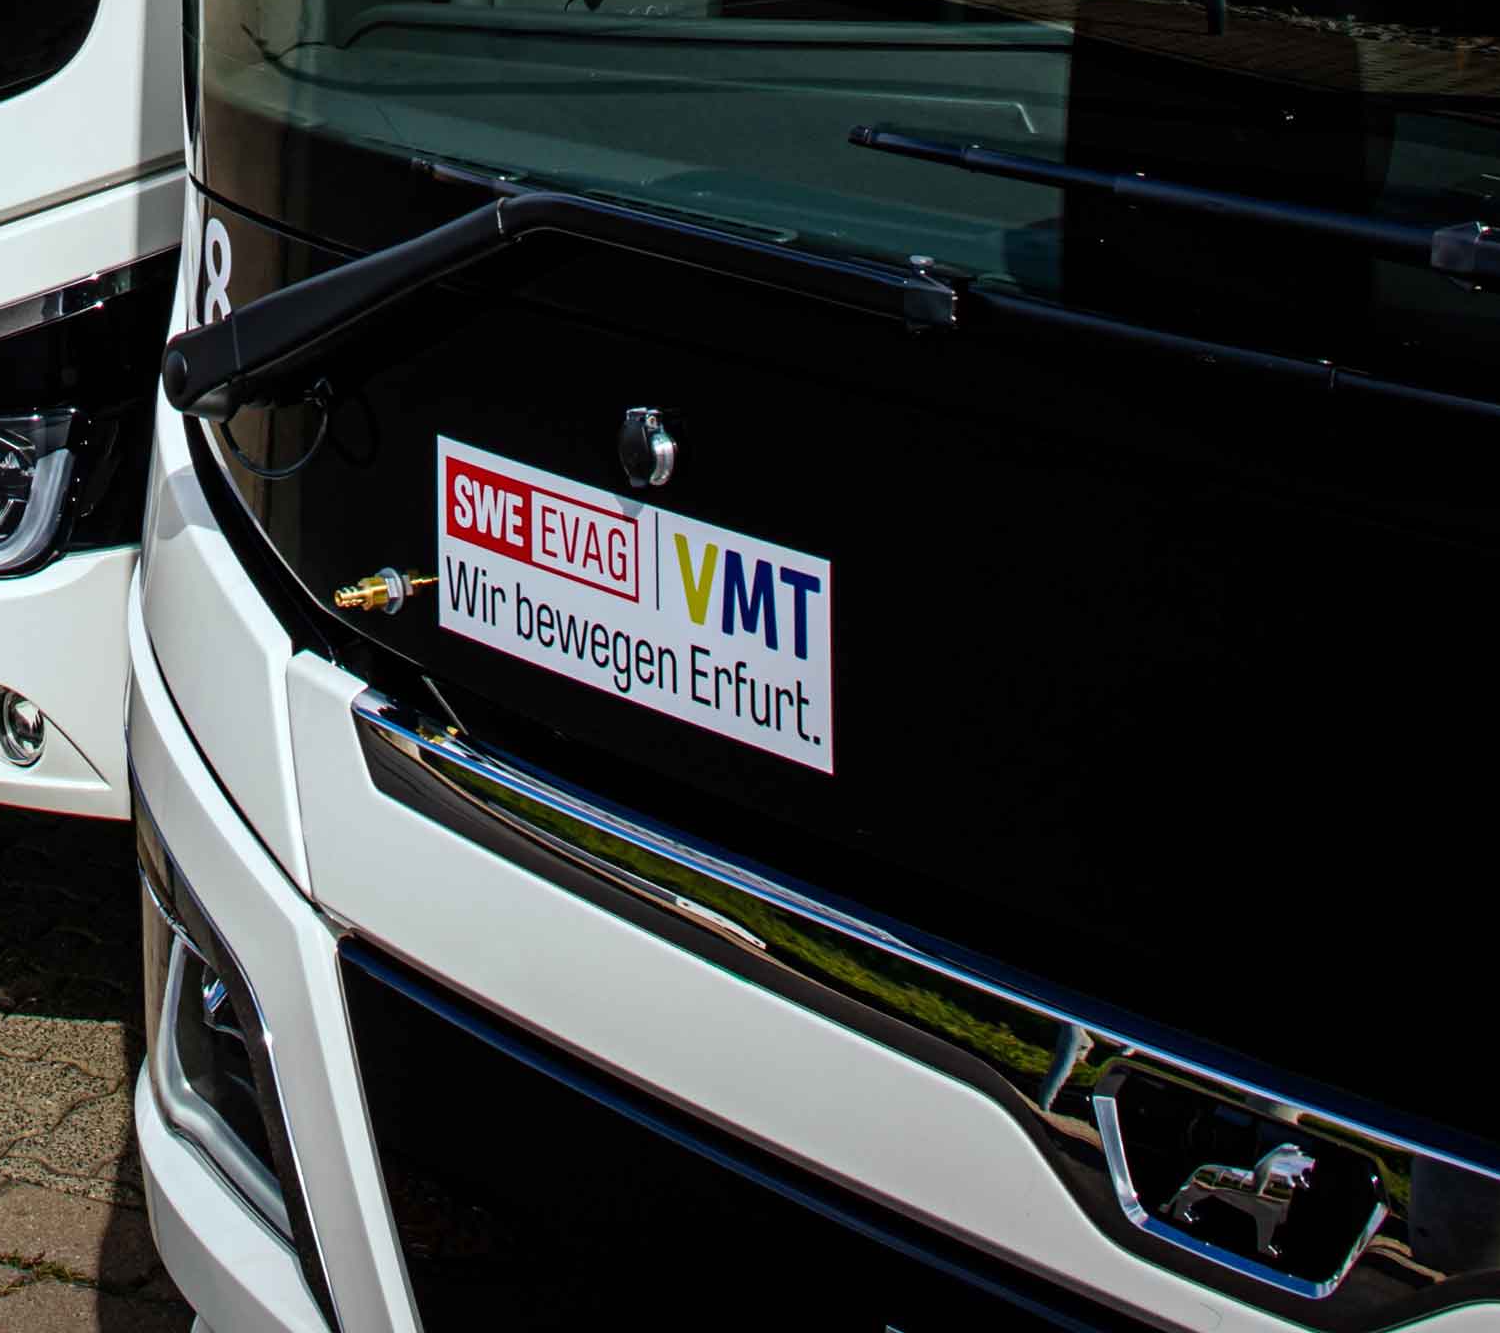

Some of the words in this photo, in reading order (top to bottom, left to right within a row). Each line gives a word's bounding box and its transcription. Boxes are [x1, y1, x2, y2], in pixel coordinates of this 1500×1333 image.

[445, 555, 506, 627] Wir
[515, 581, 679, 694] bewegen
[690, 644, 822, 746] Erfurt.
[452, 472, 526, 547] SWE
[541, 505, 628, 582] EVAG
[673, 532, 822, 661] VMT
